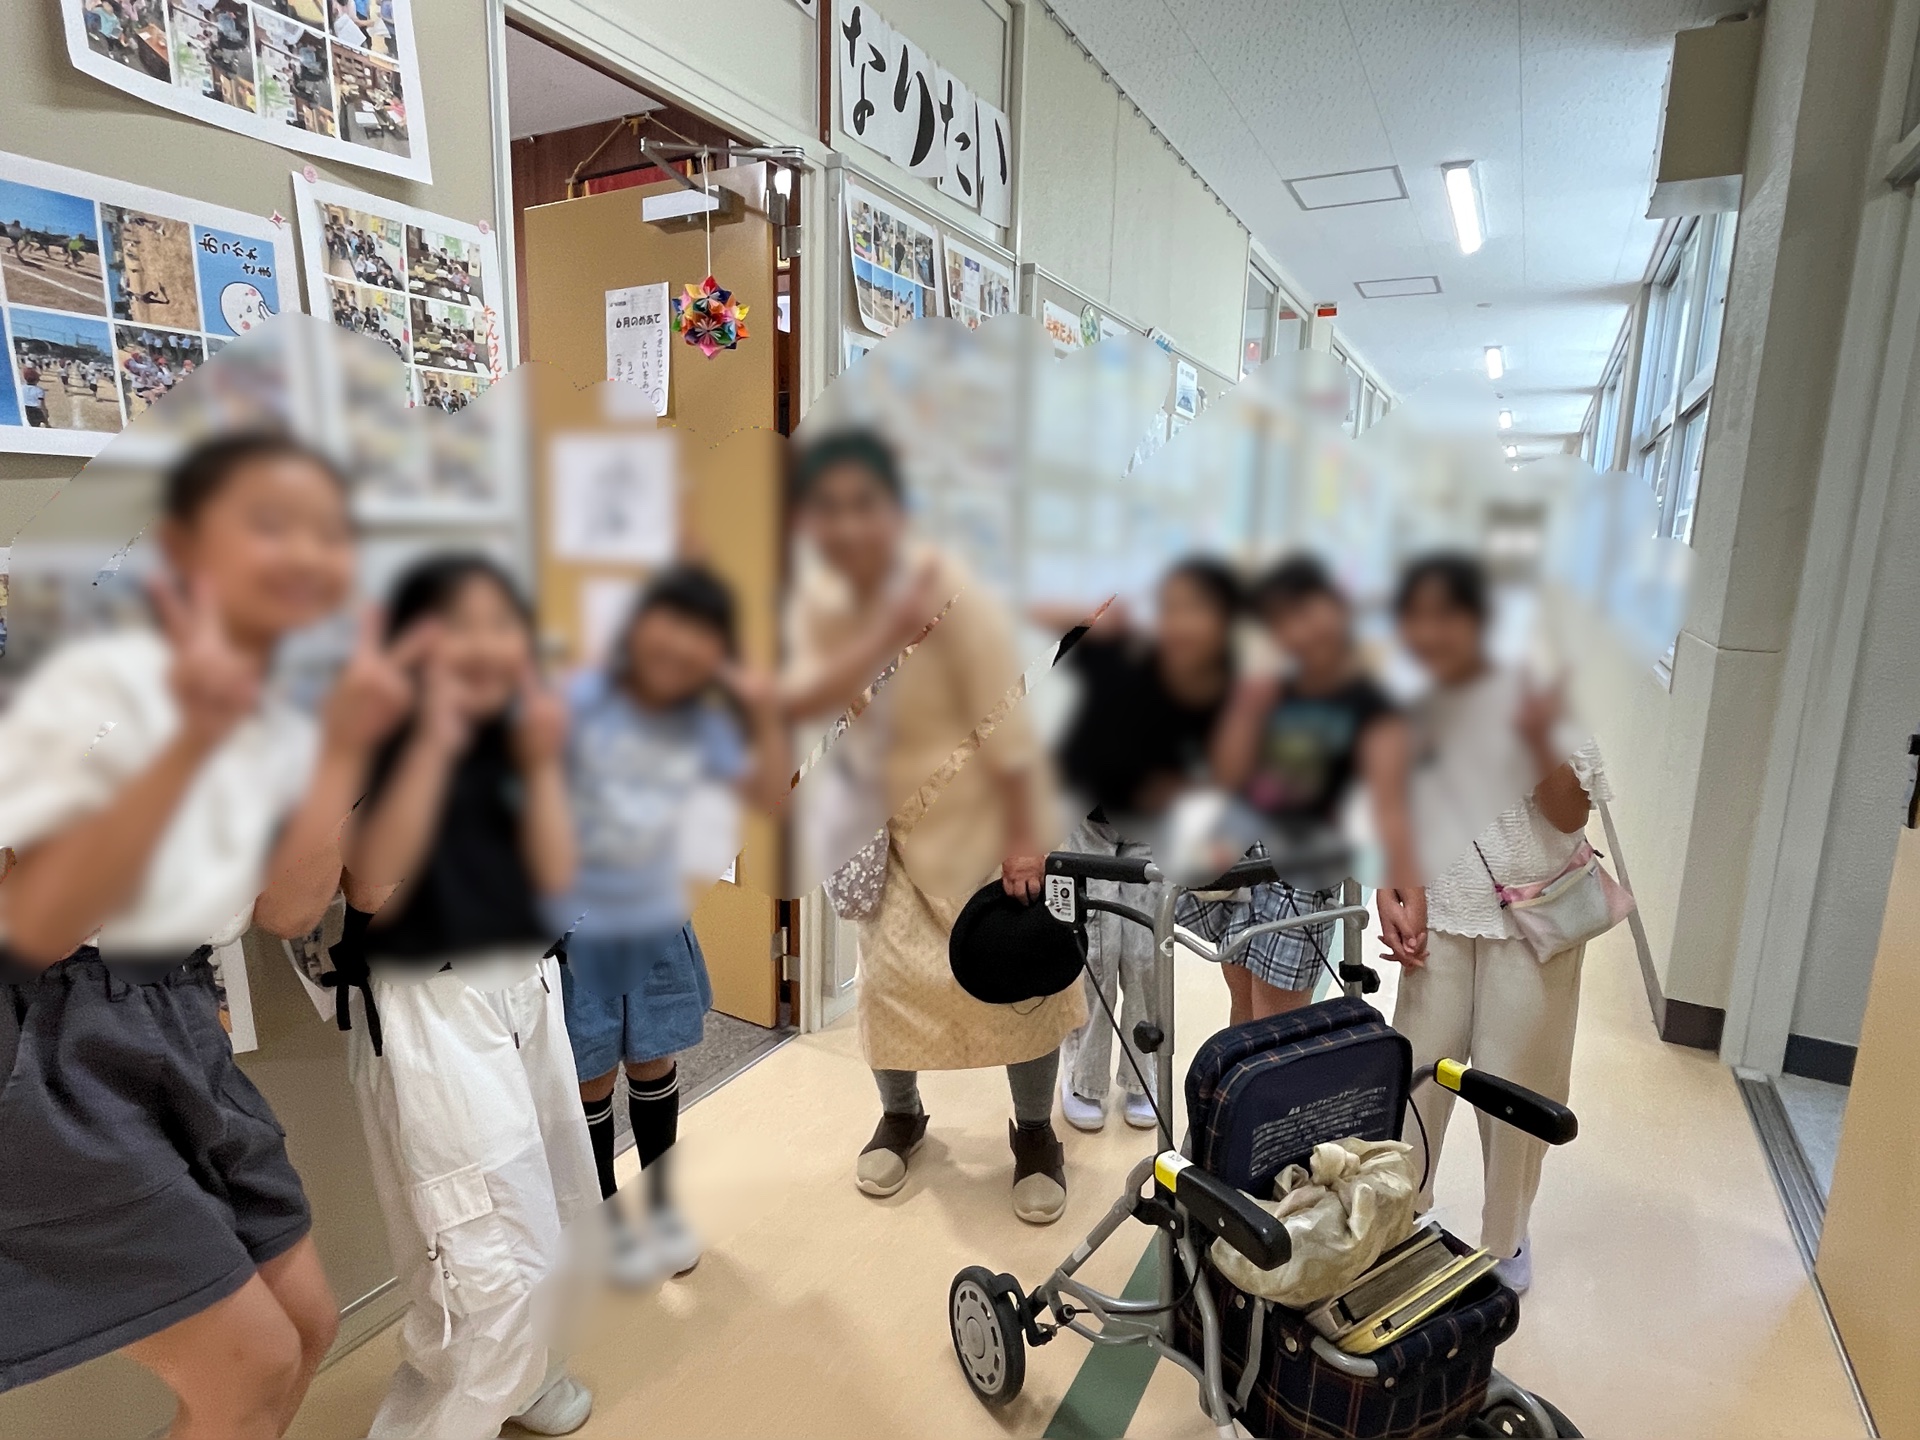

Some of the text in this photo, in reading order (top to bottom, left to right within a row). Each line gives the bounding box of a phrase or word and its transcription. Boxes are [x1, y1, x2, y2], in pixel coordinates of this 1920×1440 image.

[842, 6, 1007, 201] なりたい
[242, 262, 273, 278] さま
[615, 313, 662, 329] 6月のめあて
